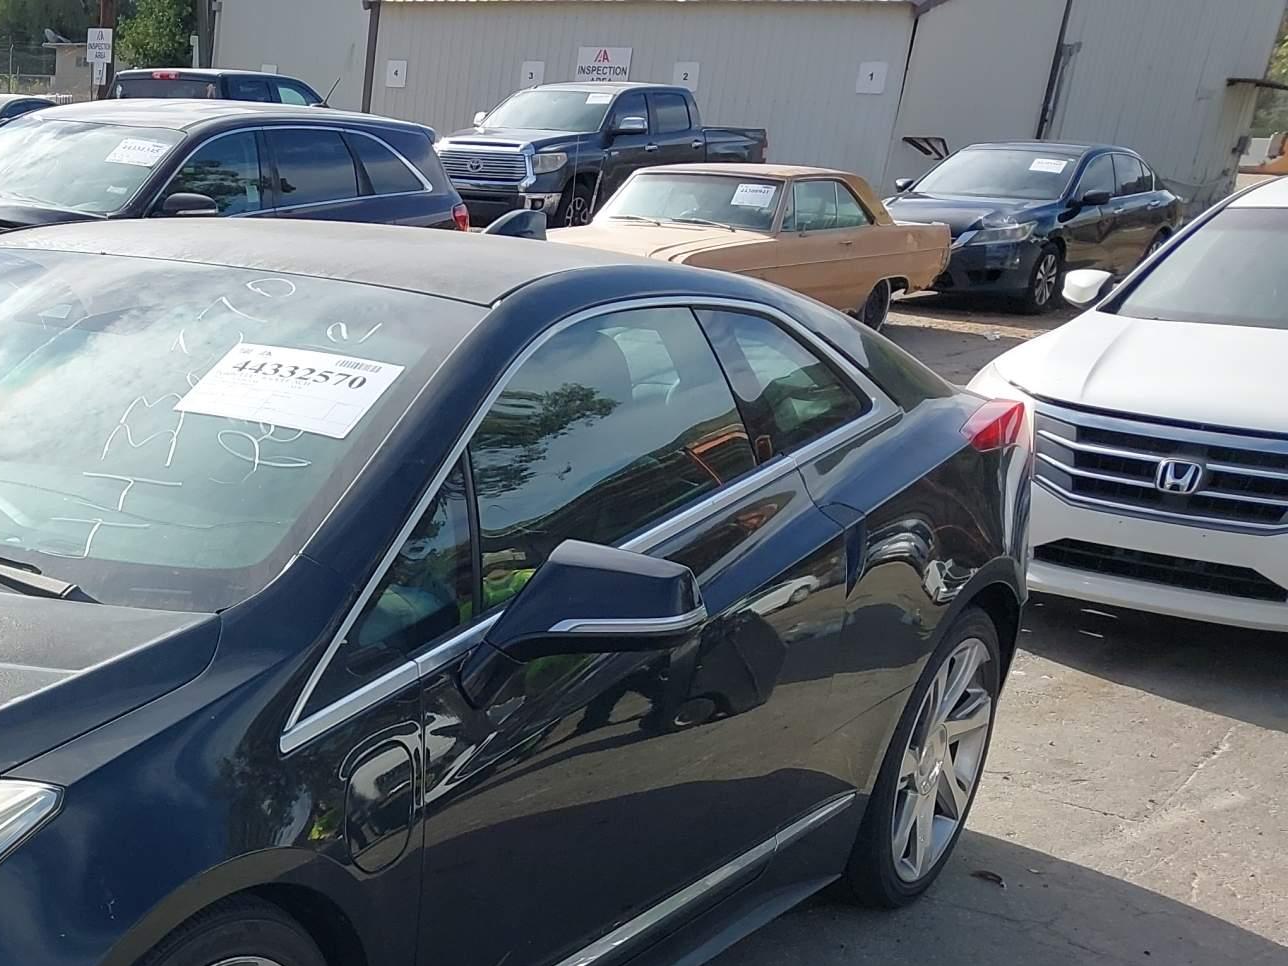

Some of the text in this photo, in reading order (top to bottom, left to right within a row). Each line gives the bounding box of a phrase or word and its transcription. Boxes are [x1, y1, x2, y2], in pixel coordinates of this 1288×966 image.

[577, 65, 628, 76] INSPECTION
[682, 72, 689, 80] 2
[231, 358, 367, 391] 44332570
